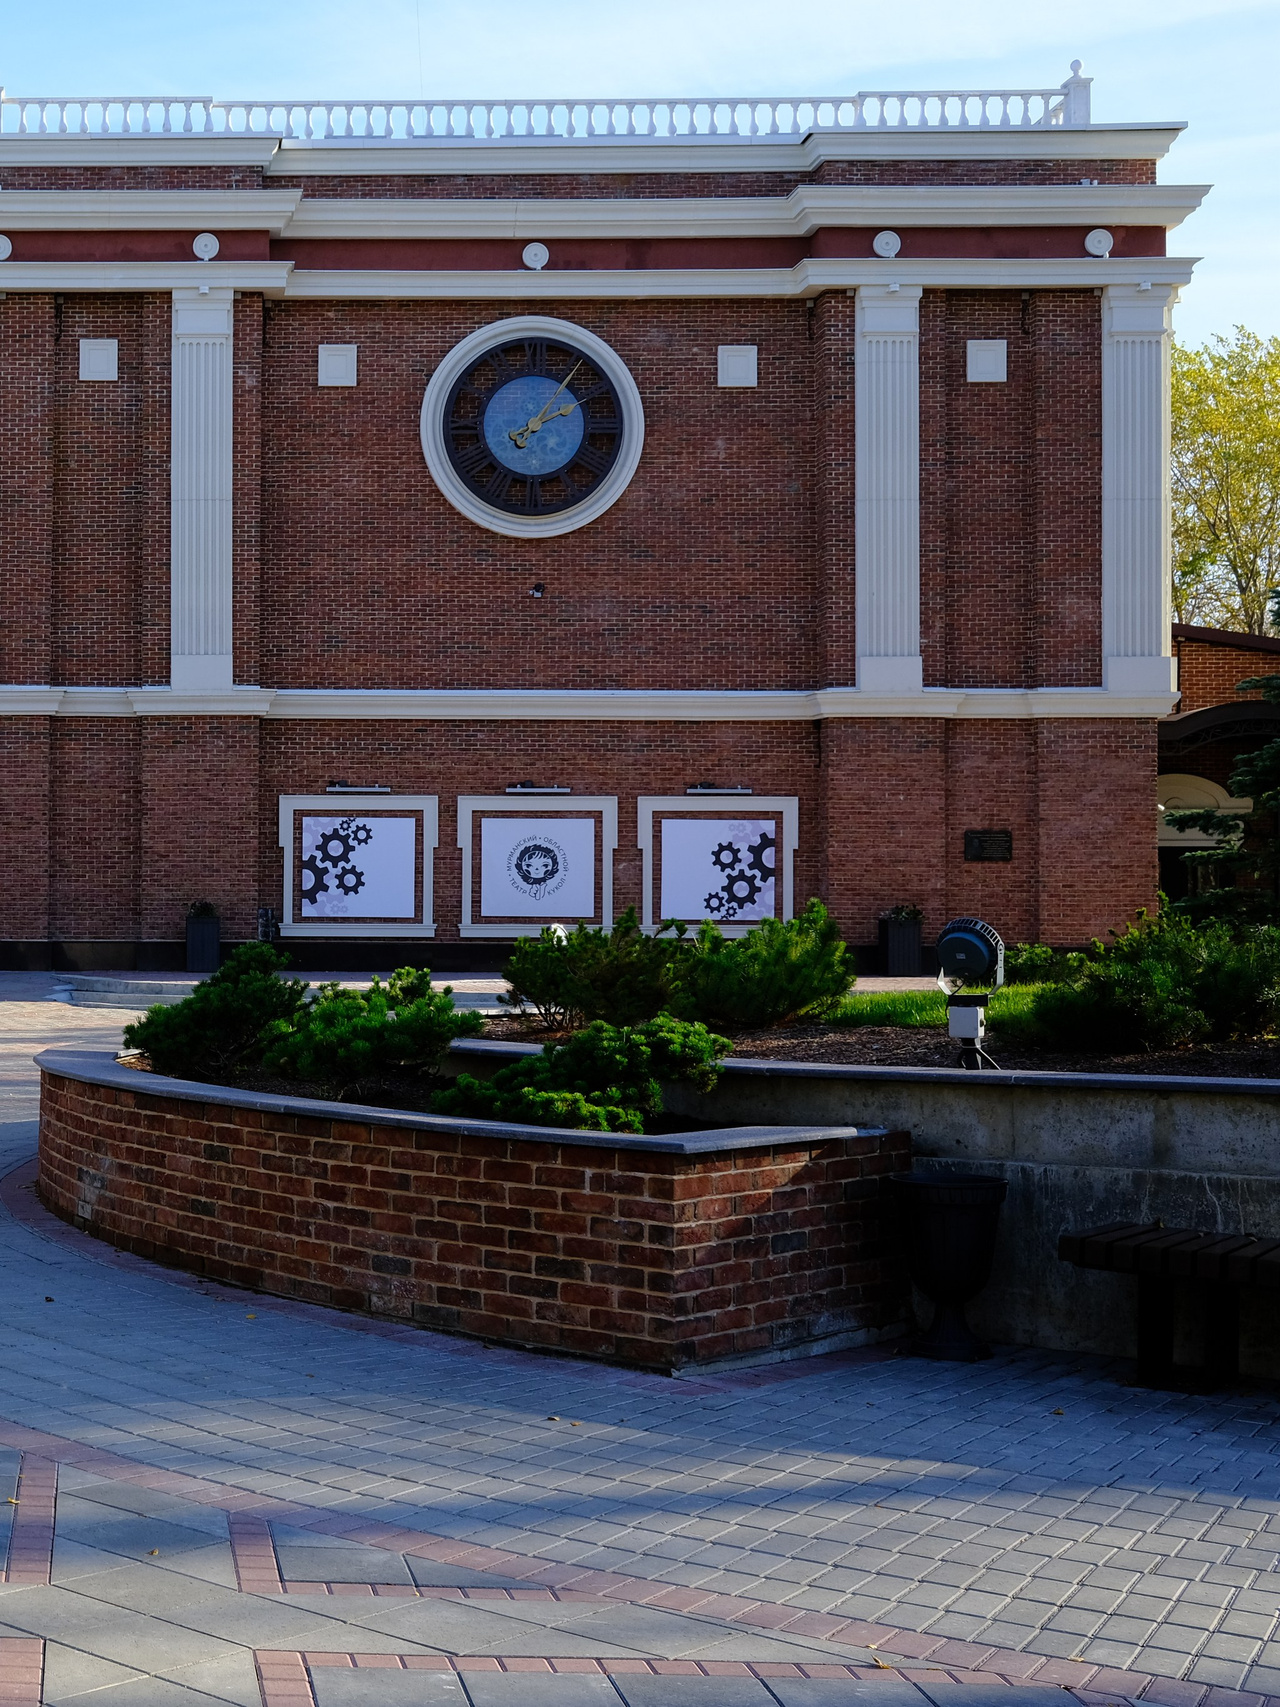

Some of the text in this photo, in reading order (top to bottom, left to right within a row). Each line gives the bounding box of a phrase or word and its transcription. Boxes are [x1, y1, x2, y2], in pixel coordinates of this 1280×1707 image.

[506, 834, 570, 872] МУРМАНСКИЙ ОБЛАСТНОЙ
[509, 877, 567, 896] ТЕАТР КУКОЛ
